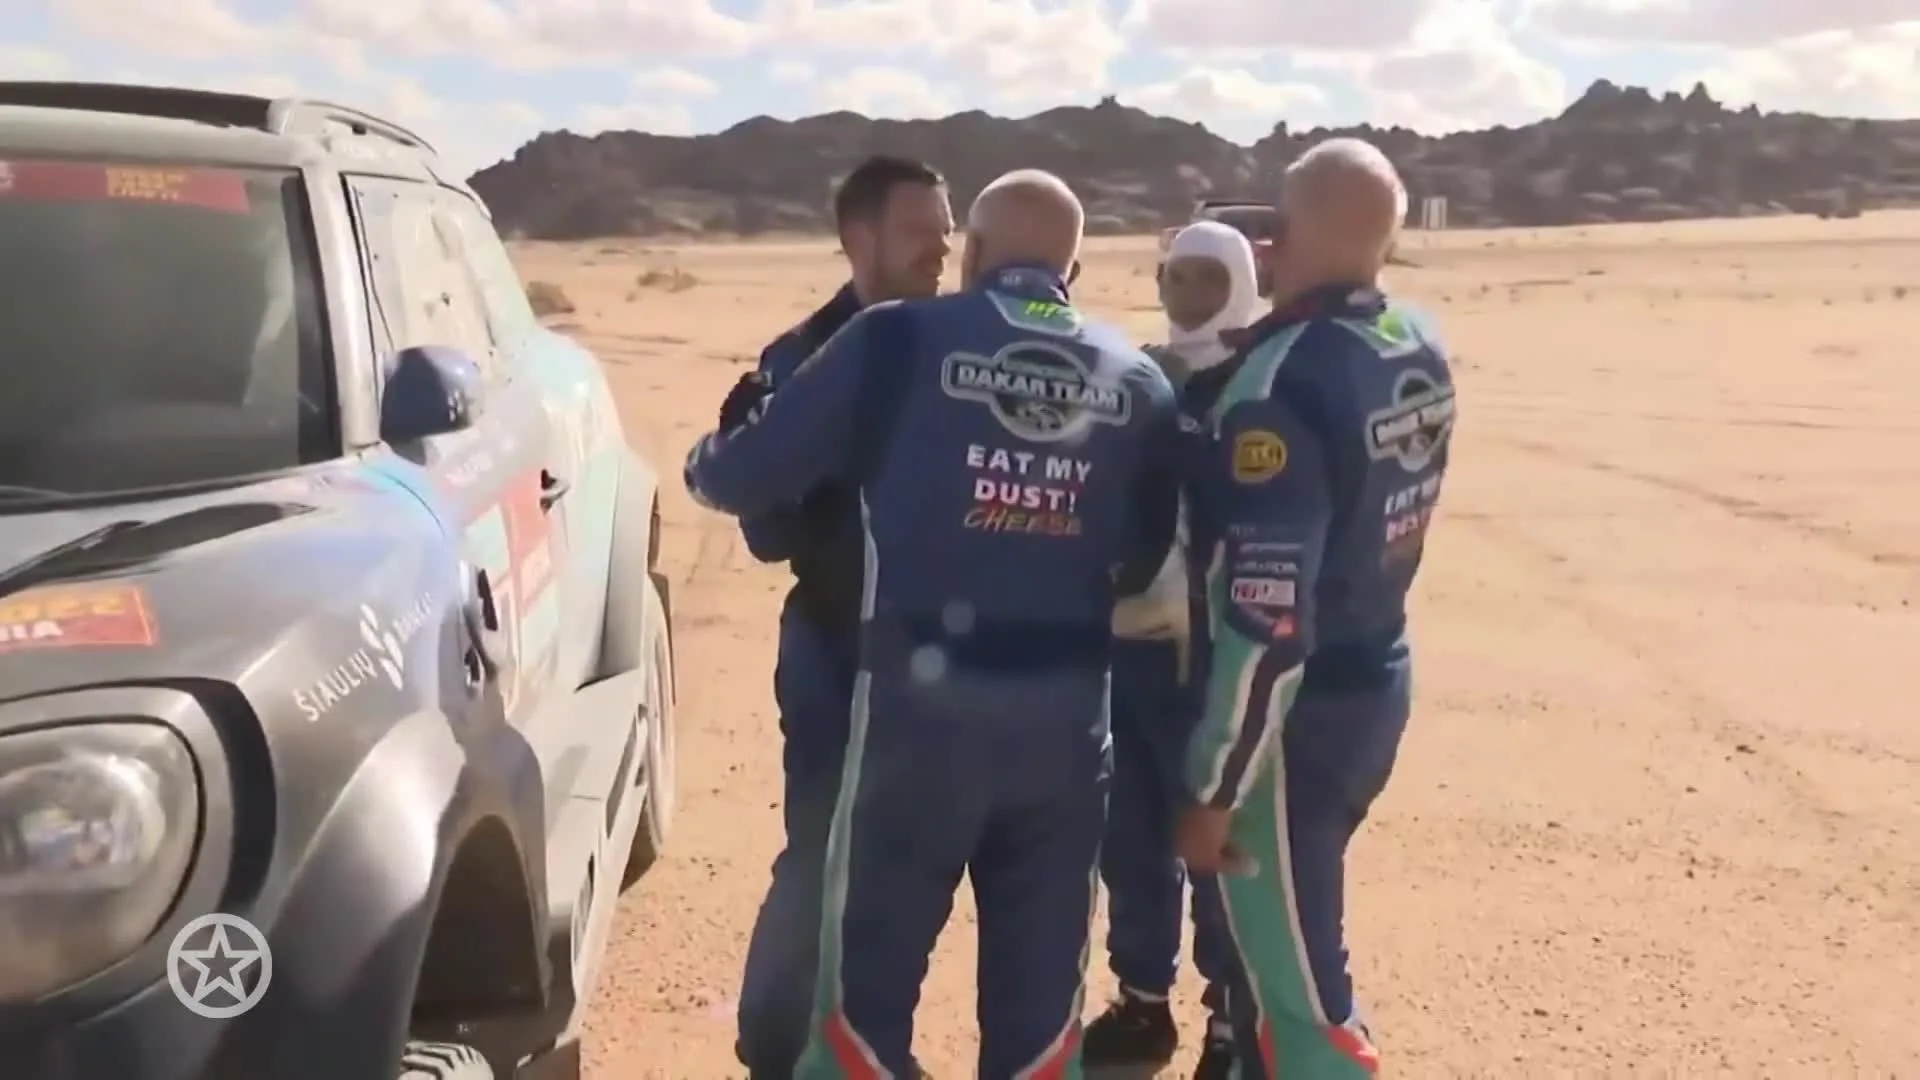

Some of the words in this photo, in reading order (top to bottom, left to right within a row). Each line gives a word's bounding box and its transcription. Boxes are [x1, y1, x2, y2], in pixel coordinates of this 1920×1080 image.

[957, 364, 1047, 399] DAKAR
[1053, 382, 1119, 410] TEAM
[966, 443, 1036, 475] EAT
[1045, 456, 1093, 484] MY
[973, 476, 1077, 514] DUST!
